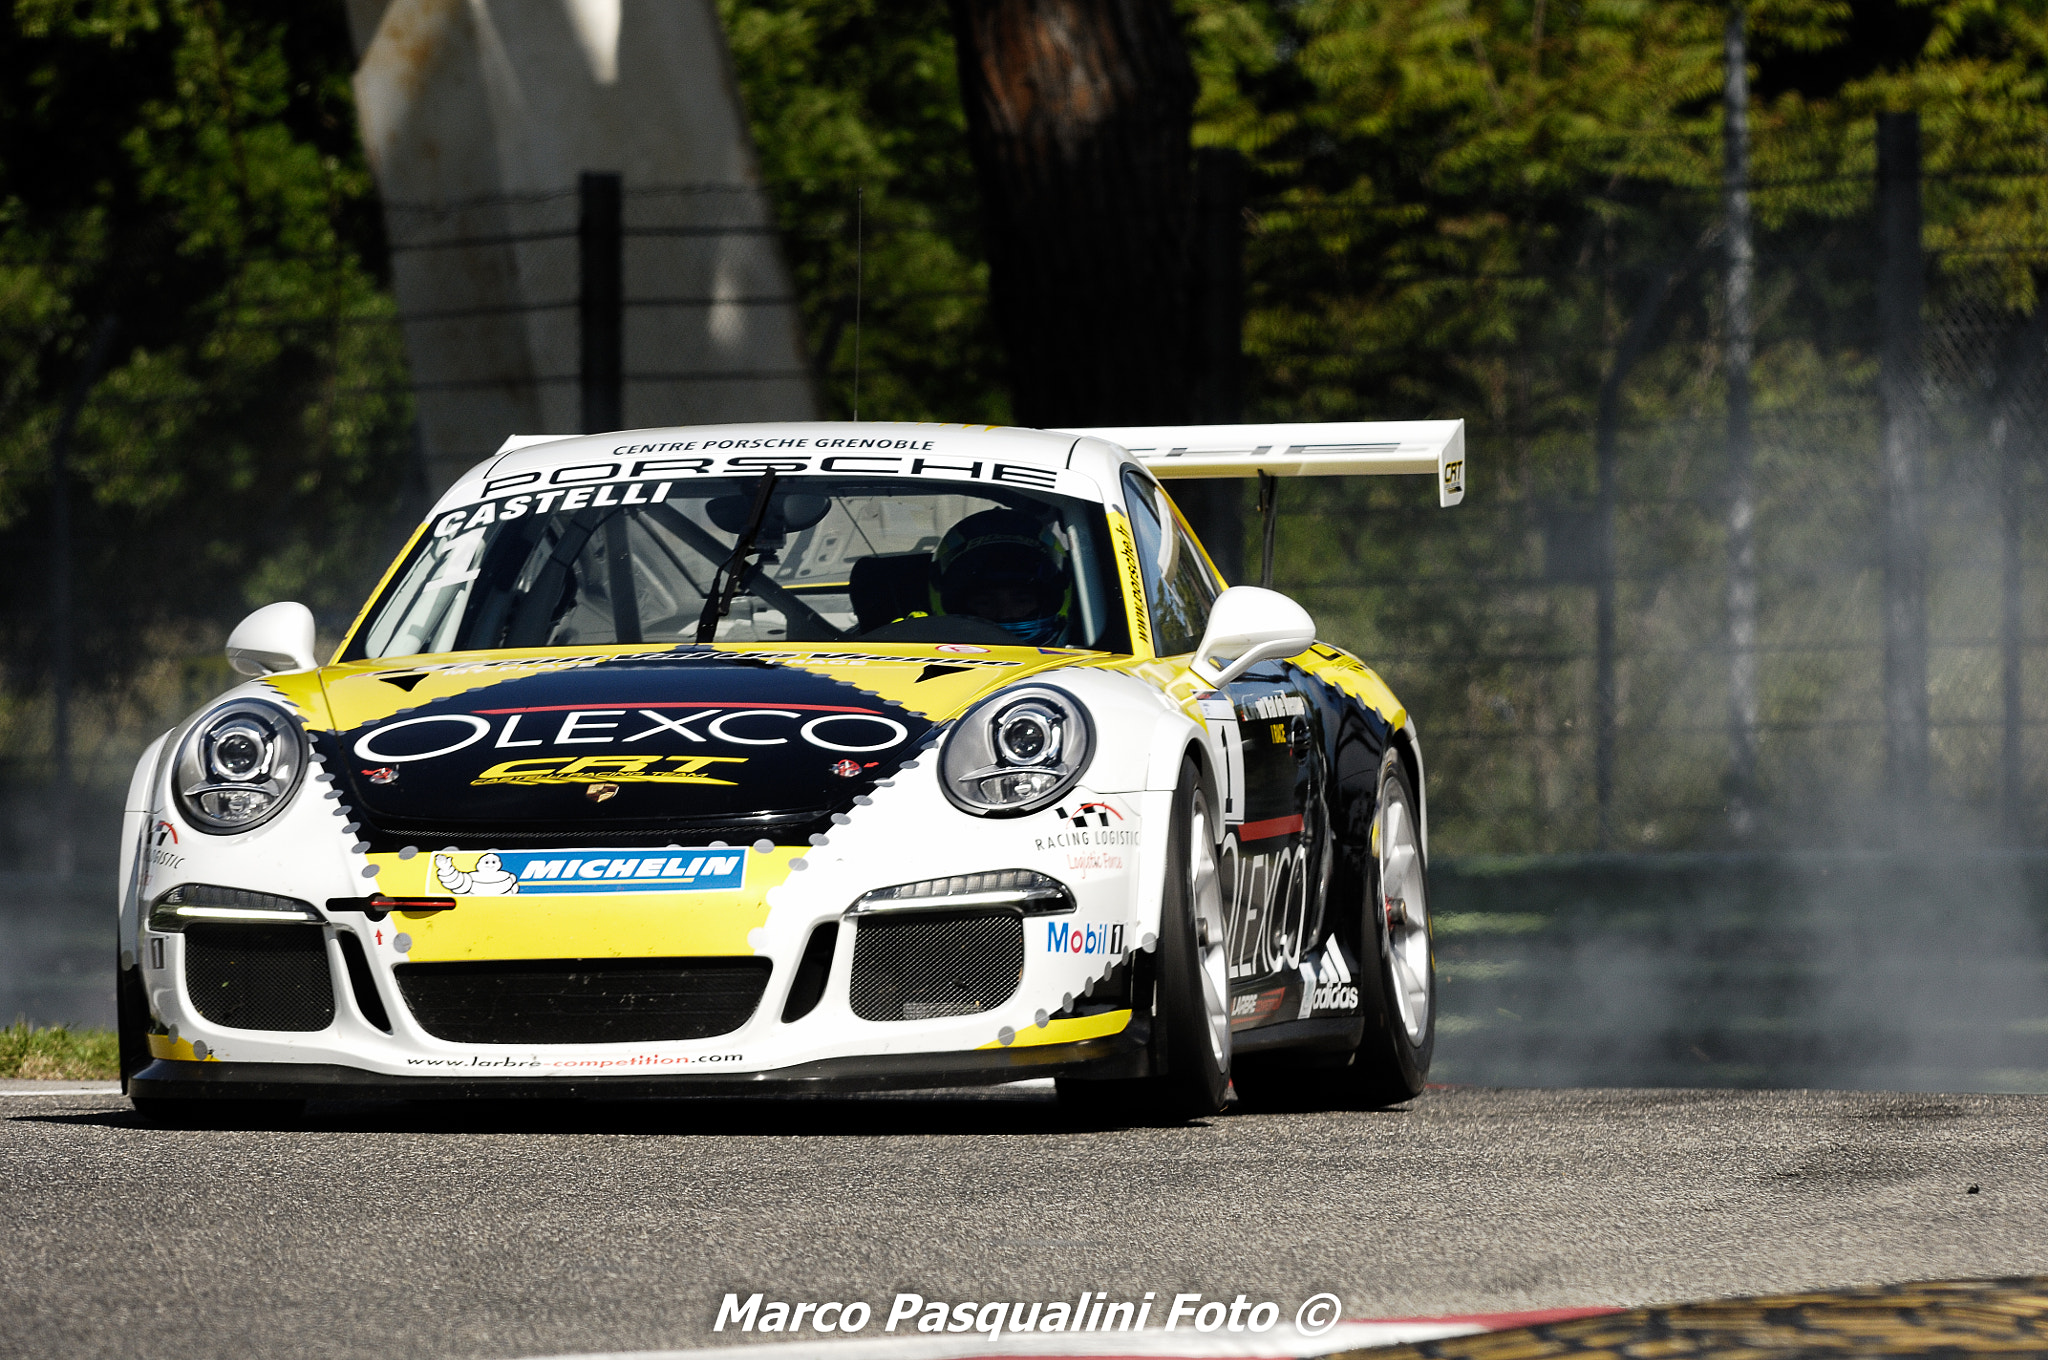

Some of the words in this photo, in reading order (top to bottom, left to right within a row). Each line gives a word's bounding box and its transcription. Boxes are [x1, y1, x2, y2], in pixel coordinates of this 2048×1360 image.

[613, 441, 700, 455] CENTRE
[702, 438, 809, 452] PORSCHE
[815, 438, 935, 451] GRENOBLE
[480, 456, 1058, 499] PORSCHE
[434, 482, 673, 538] CASTELLI
[422, 526, 488, 592] 1
[353, 709, 908, 763] OLEXCO
[478, 755, 750, 779] CRT
[1035, 831, 1090, 850] RACING
[1095, 830, 1140, 846] LOGISTIC
[519, 856, 742, 880] MICHELIN
[1047, 921, 1108, 955] Mobil
[1111, 925, 1124, 955] 1
[1313, 982, 1359, 1010] adidas
